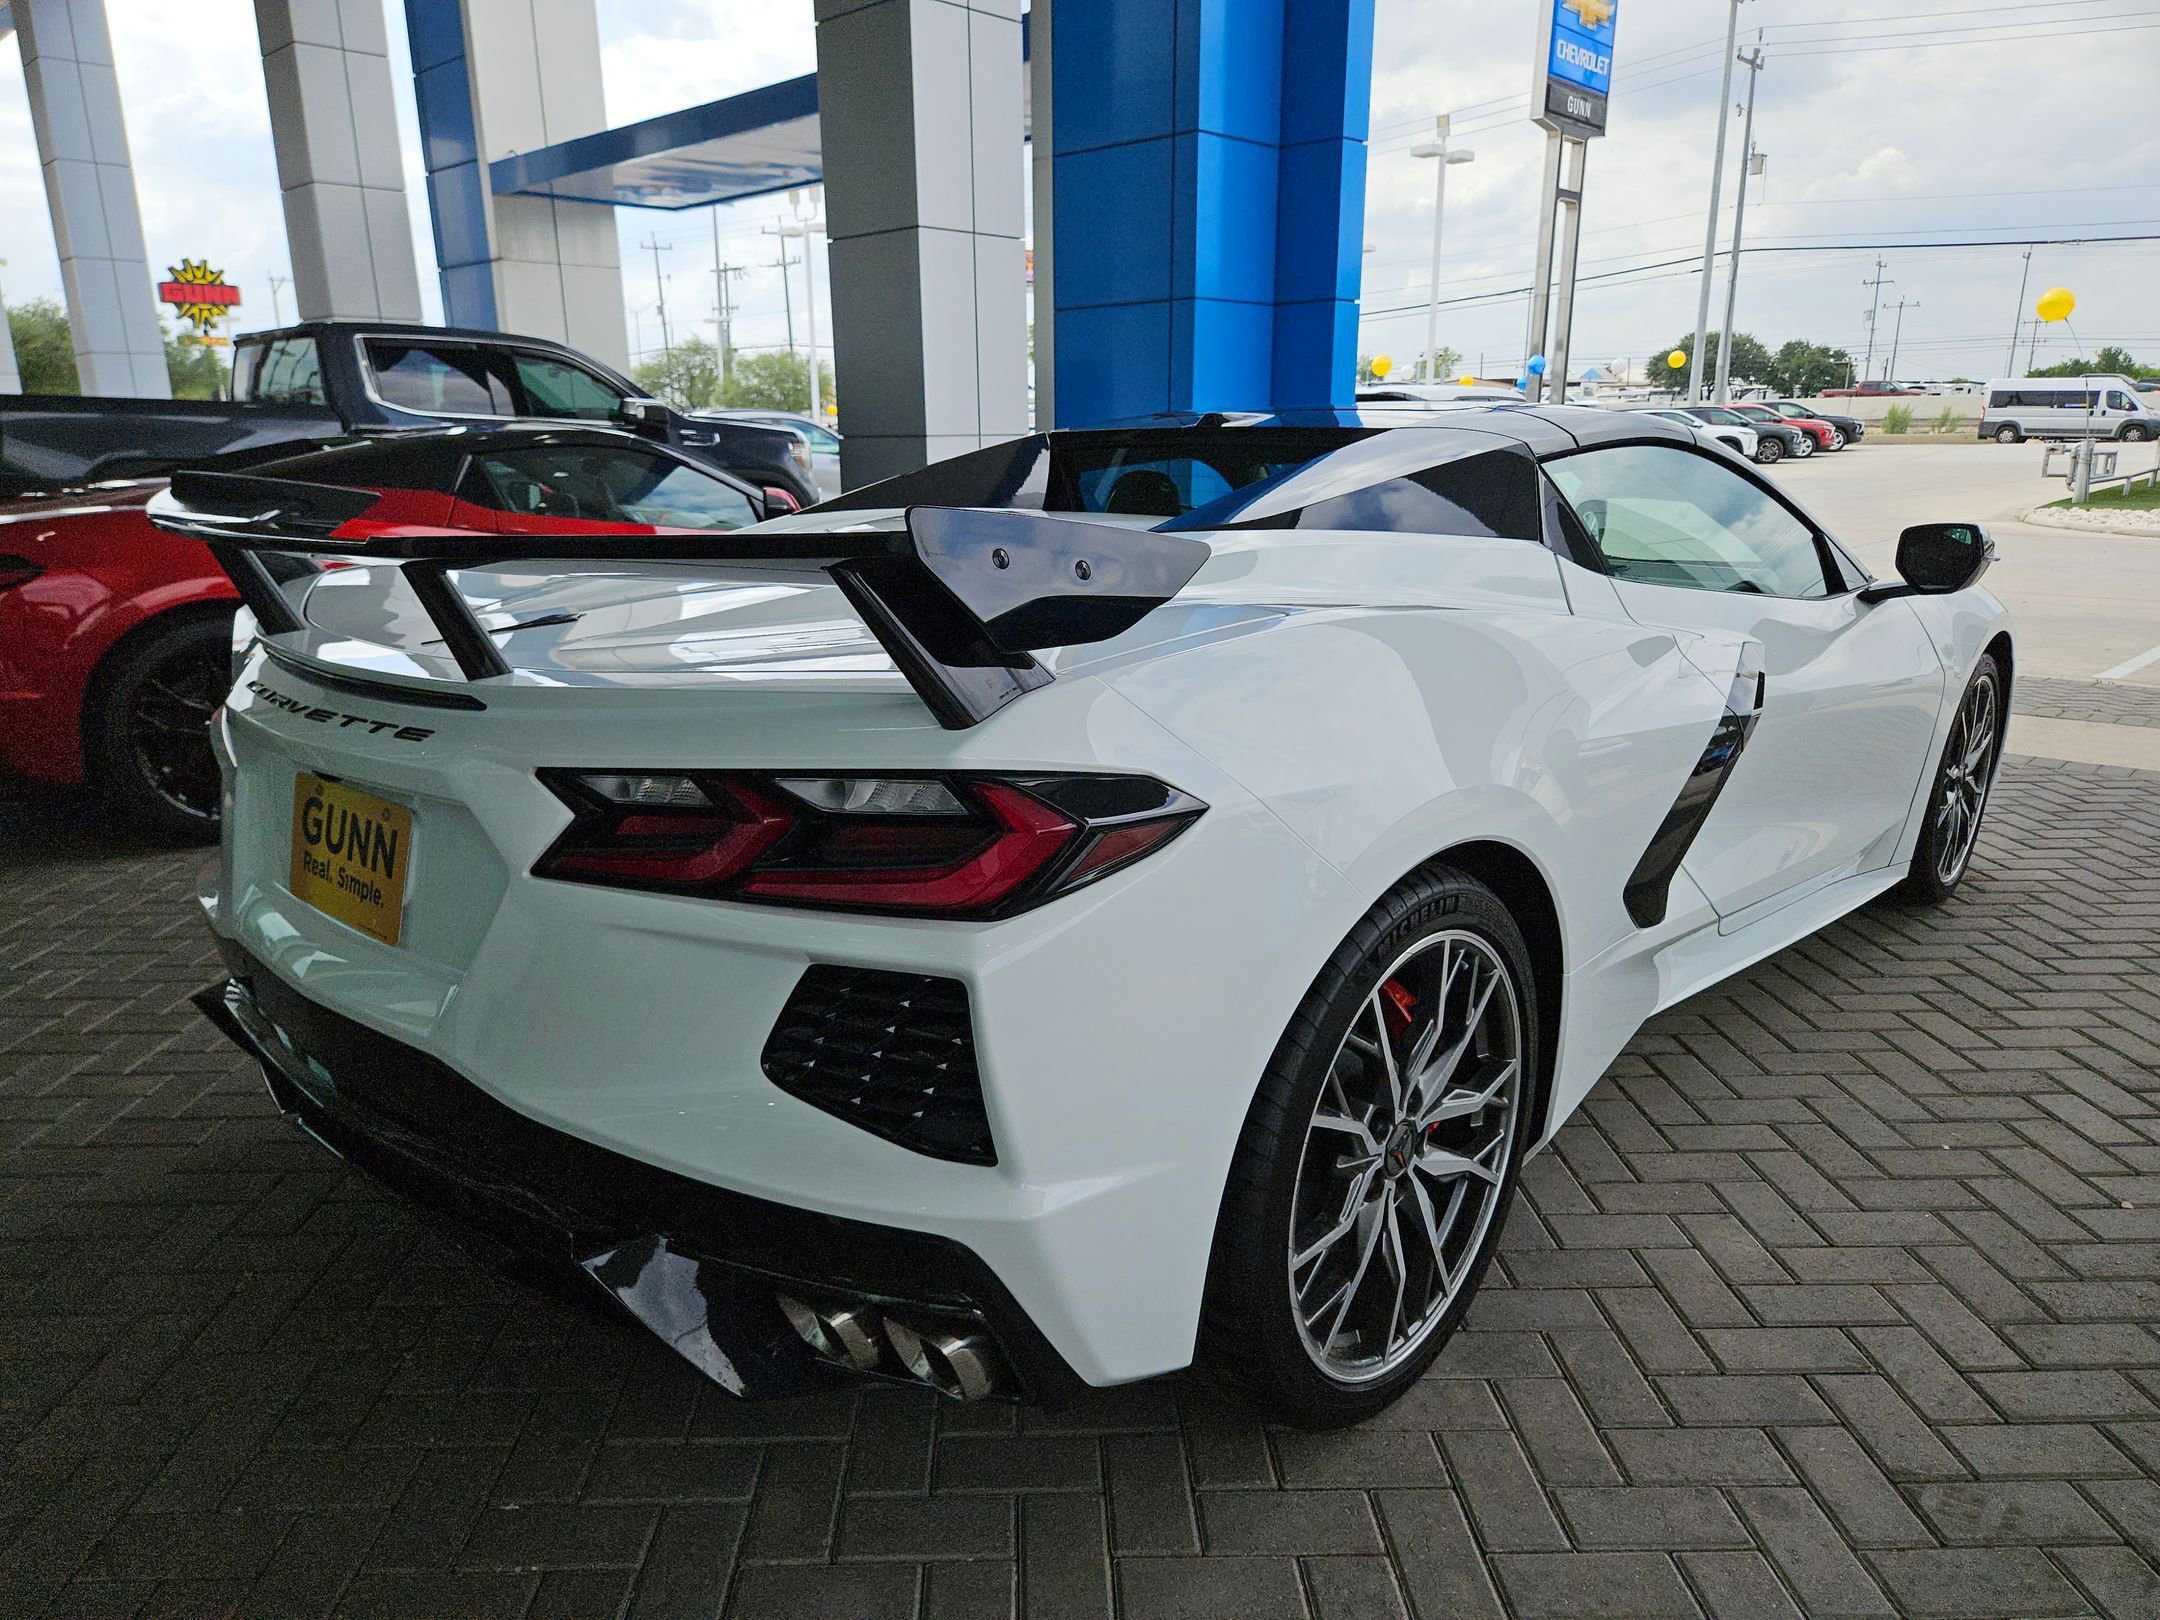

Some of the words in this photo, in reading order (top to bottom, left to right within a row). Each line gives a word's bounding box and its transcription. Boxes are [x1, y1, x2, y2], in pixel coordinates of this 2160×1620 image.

[1557, 39, 1609, 75] CHEVROLET
[1567, 96, 1592, 118] GUNN
[162, 283, 240, 305] GUNN
[246, 681, 436, 741] CORVETTE
[302, 796, 398, 879] GUNN
[303, 850, 332, 883] Real.
[338, 866, 384, 907] Simple.
[1378, 895, 1459, 958] MICHELIN
